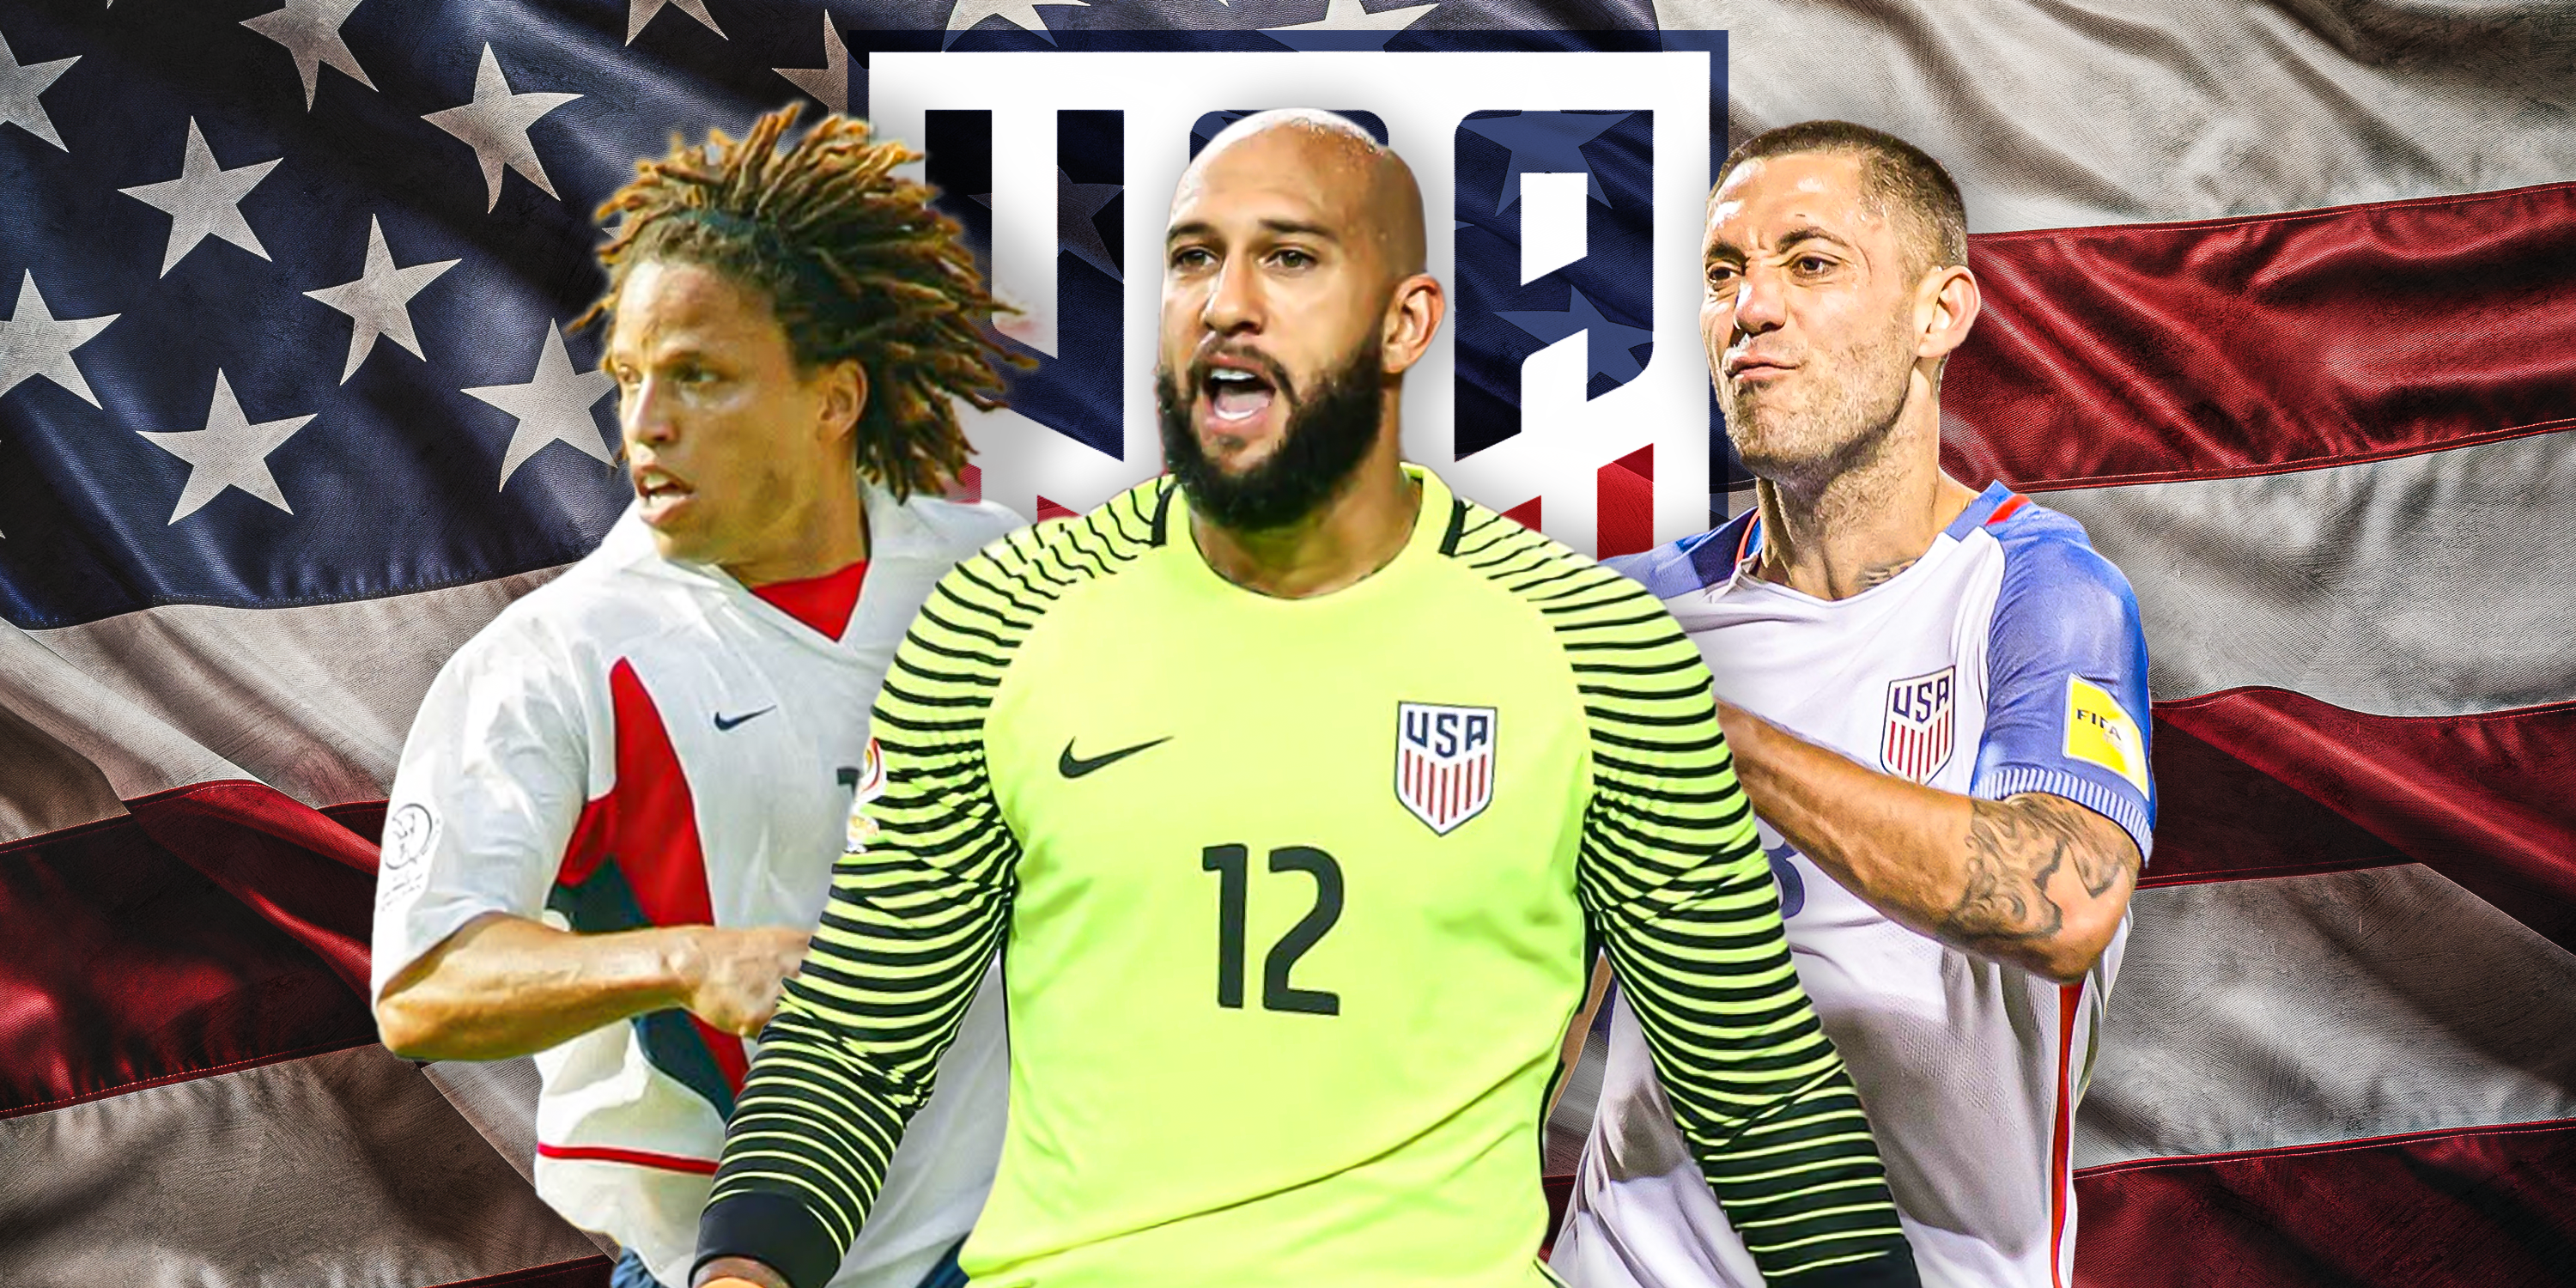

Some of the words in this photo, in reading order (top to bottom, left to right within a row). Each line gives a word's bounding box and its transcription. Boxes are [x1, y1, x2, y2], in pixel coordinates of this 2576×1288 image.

[1893, 675, 1949, 724] USA
[1406, 711, 1488, 758] USA
[2076, 708, 2122, 741] FIFA
[1202, 843, 1345, 1016] 12
